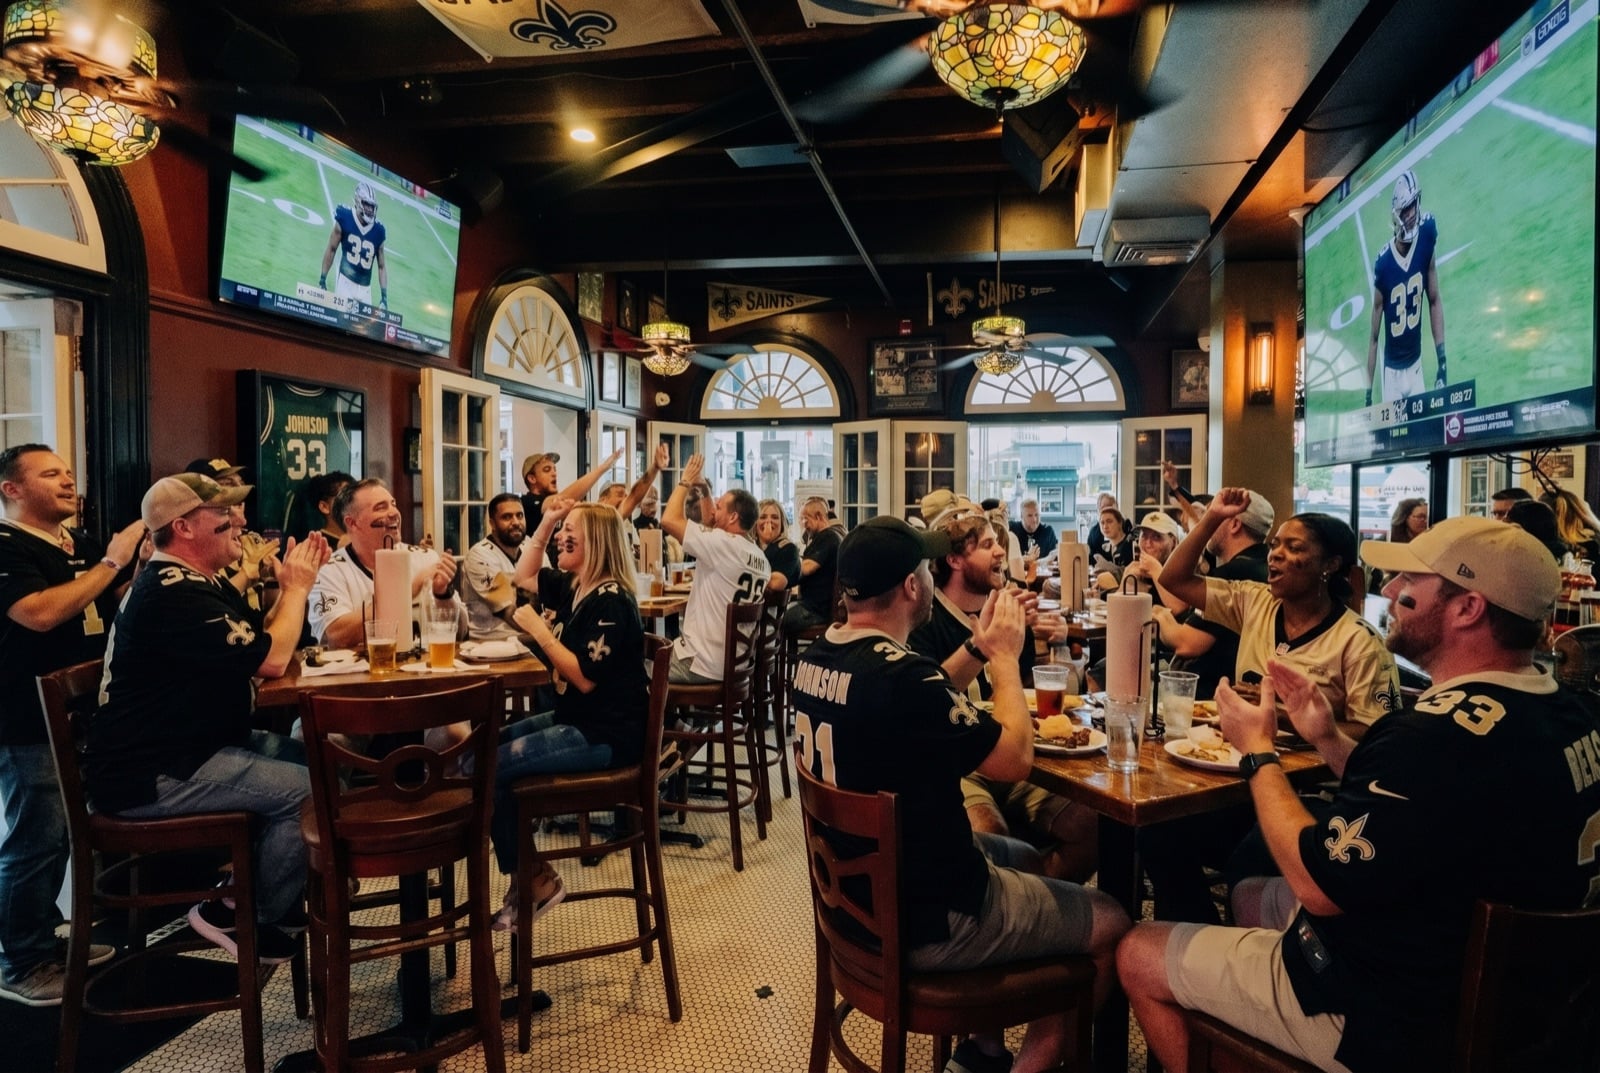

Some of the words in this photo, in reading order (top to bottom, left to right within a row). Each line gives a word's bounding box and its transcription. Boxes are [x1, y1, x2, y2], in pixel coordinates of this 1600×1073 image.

[346, 233, 375, 270] 33
[746, 290, 795, 311] SAINTS
[978, 278, 1026, 309] SANTS
[1390, 271, 1423, 337] 33
[284, 414, 329, 435] JOHNSON
[286, 438, 327, 481] 33
[793, 659, 852, 706] JOHNSON
[1414, 690, 1508, 736] 33
